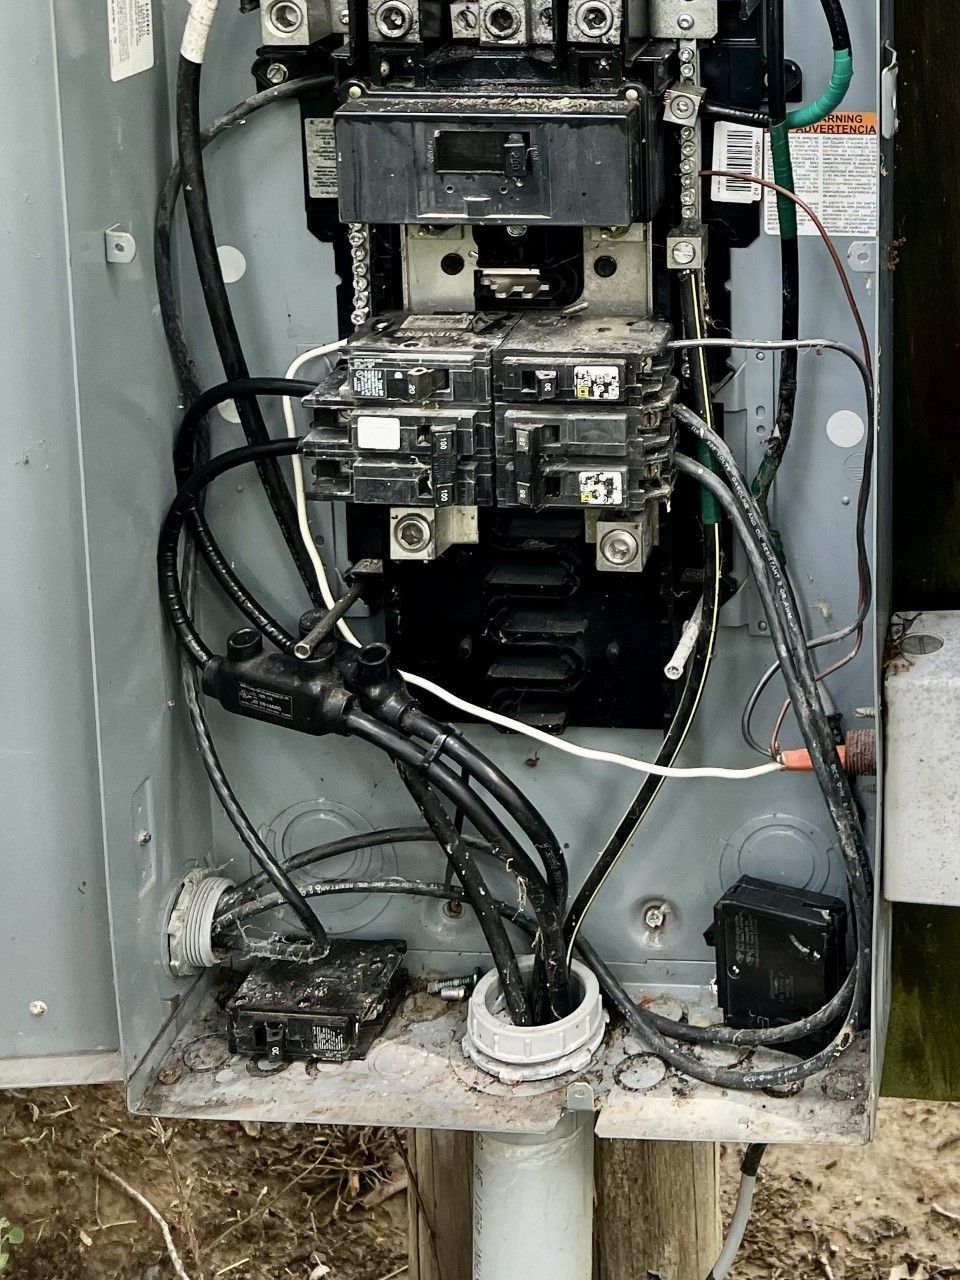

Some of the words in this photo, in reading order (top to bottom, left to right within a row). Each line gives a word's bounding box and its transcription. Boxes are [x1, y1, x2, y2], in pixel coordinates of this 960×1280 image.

[818, 114, 863, 124] ARNING
[795, 124, 877, 134] ADVERTENCIA
[439, 437, 448, 450] 100
[440, 489, 449, 502] 100
[730, 475, 750, 510] GASOLINE
[747, 512, 758, 527] AND
[754, 527, 763, 541] OIL
[760, 541, 782, 580] RESISTANT
[271, 1046, 280, 1056] 20
